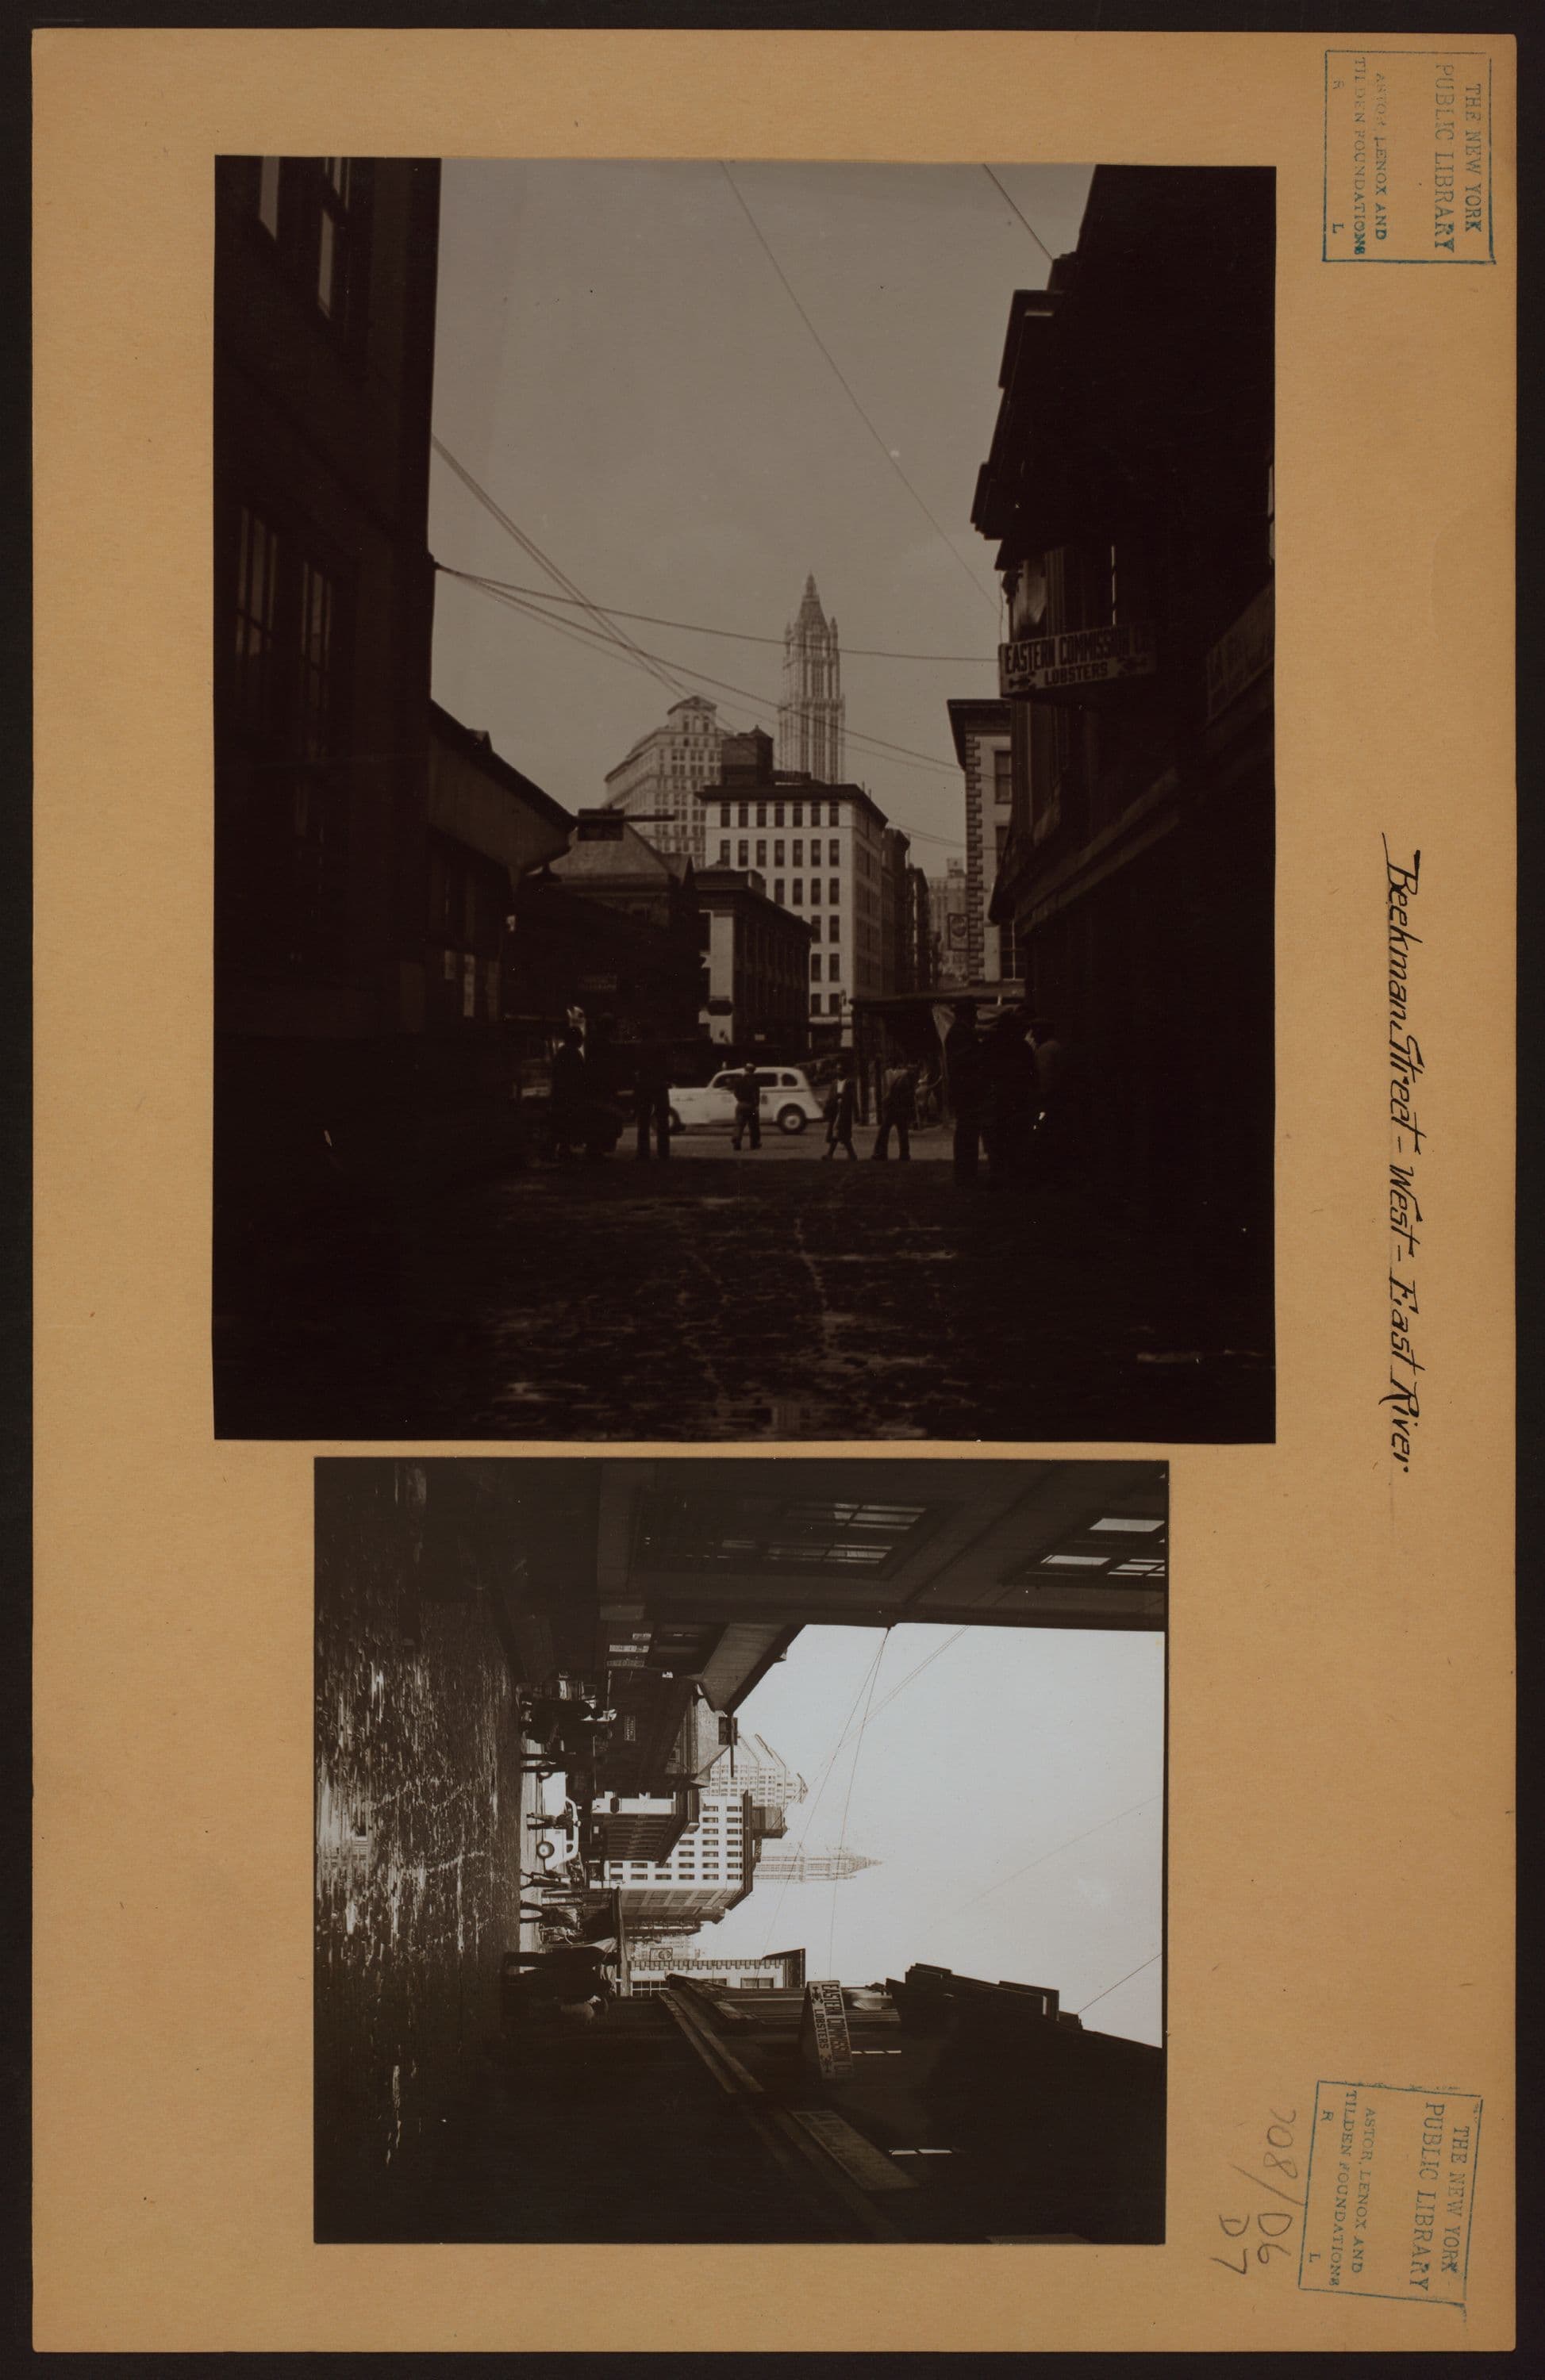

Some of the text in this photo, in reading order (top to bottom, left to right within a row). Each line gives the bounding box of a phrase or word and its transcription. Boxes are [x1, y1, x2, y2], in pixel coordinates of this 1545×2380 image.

[1354, 130, 1366, 255] FOUNDATIONS
[1374, 136, 1386, 195] LENOX
[1435, 63, 1455, 252] PUBLIC LIBRARY
[1466, 84, 1482, 232] THE NEW YORK
[1333, 223, 1344, 233] L
[1375, 203, 1387, 240] AND
[1005, 639, 1055, 674] EASTERN
[1045, 662, 1108, 685] LOBSTERS
[1382, 833, 1422, 1023] Beekman
[1388, 1164, 1424, 1255] West
[1388, 1266, 1424, 1372] East
[1378, 1364, 1420, 1472] River
[814, 2010, 828, 2049] LOBSTERS
[822, 1984, 842, 2016] EASTERN
[827, 2018, 851, 2063] COMMISSION
[1309, 2109, 1333, 2263] R L
[1329, 2090, 1358, 2286] TILDEN FOUNDATIONS
[1351, 2107, 1376, 2274] ASTOR, LENOX AND
[1409, 2102, 1445, 2290] PUBLIC LIBRARY
[1441, 2126, 1470, 2274] THE NEW YORK
